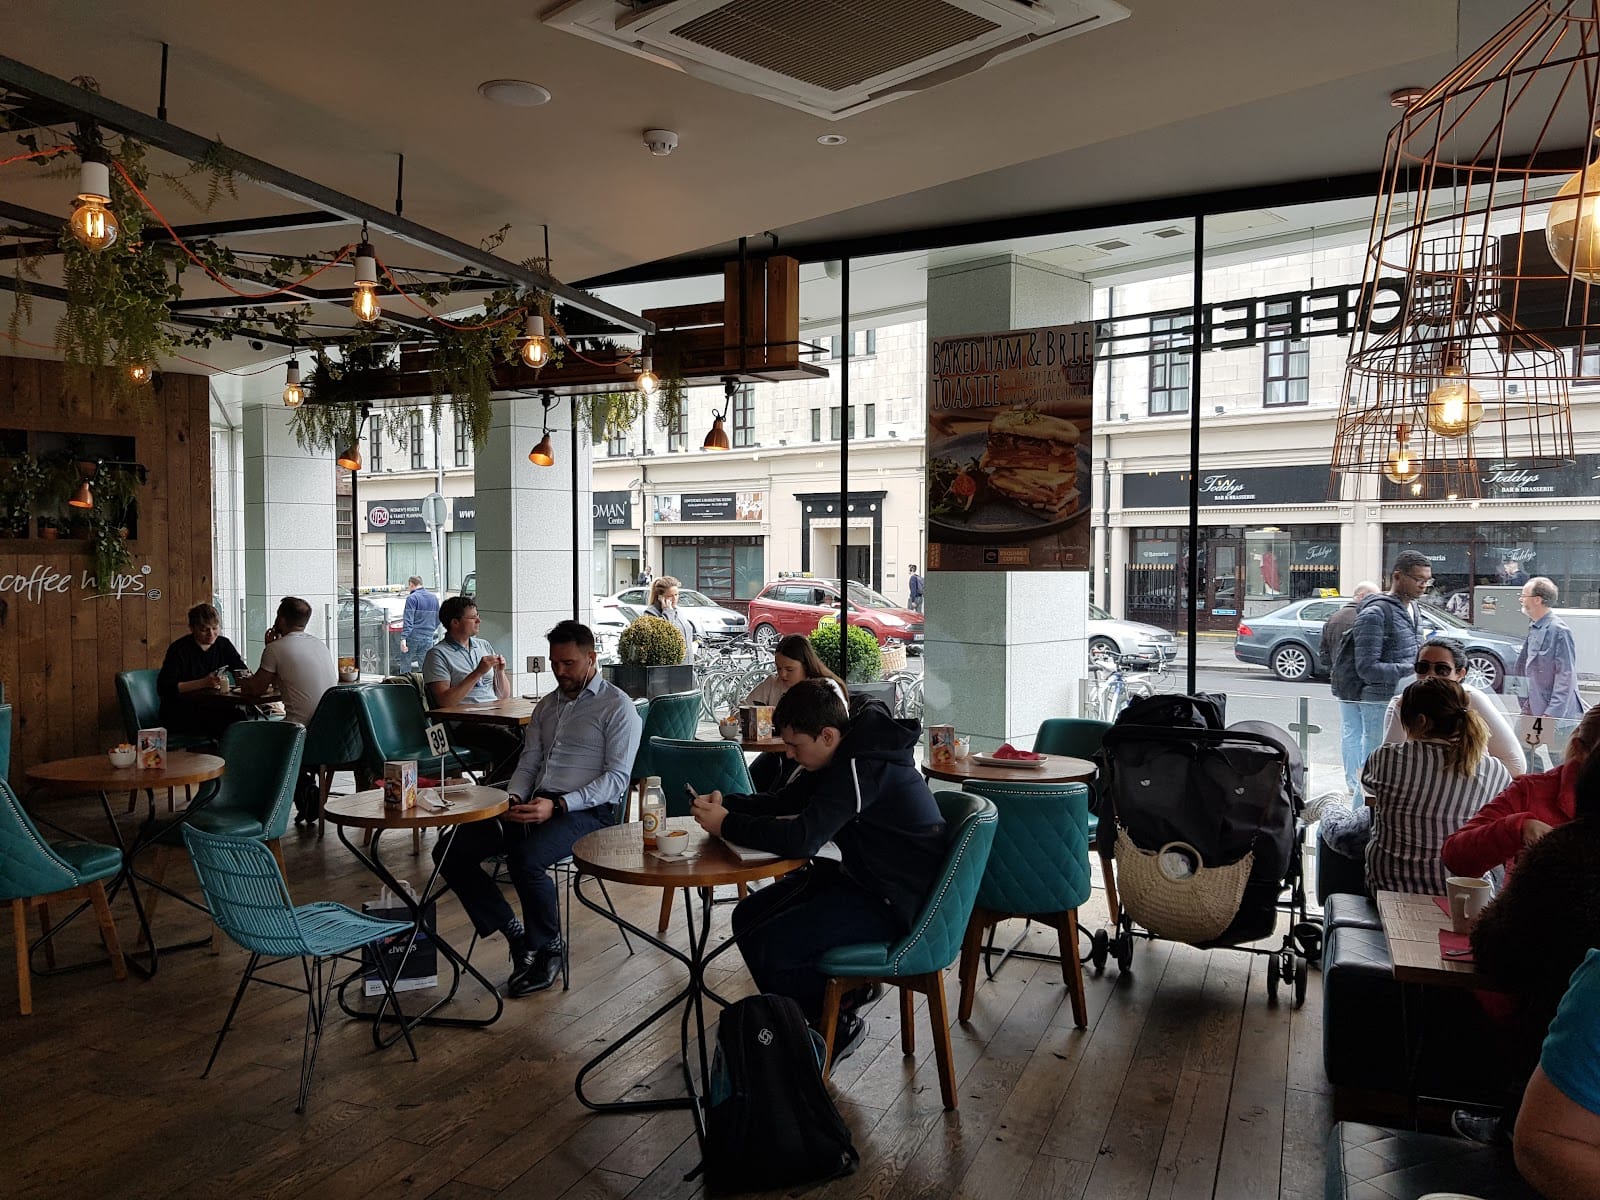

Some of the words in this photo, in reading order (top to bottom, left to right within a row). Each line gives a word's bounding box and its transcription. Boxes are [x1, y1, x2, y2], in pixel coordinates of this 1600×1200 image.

[933, 341, 980, 376] BAKED
[984, 335, 1022, 371] HAM
[1026, 332, 1042, 367] &
[1046, 330, 1090, 367] BRIE
[932, 374, 1001, 409] TOASTIE
[1481, 463, 1540, 487] Toddys
[593, 503, 625, 518] OMAN
[608, 517, 625, 525] Centre
[0, 565, 72, 604] coffee
[1532, 717, 1543, 735] 4
[430, 729, 446, 750] 39
